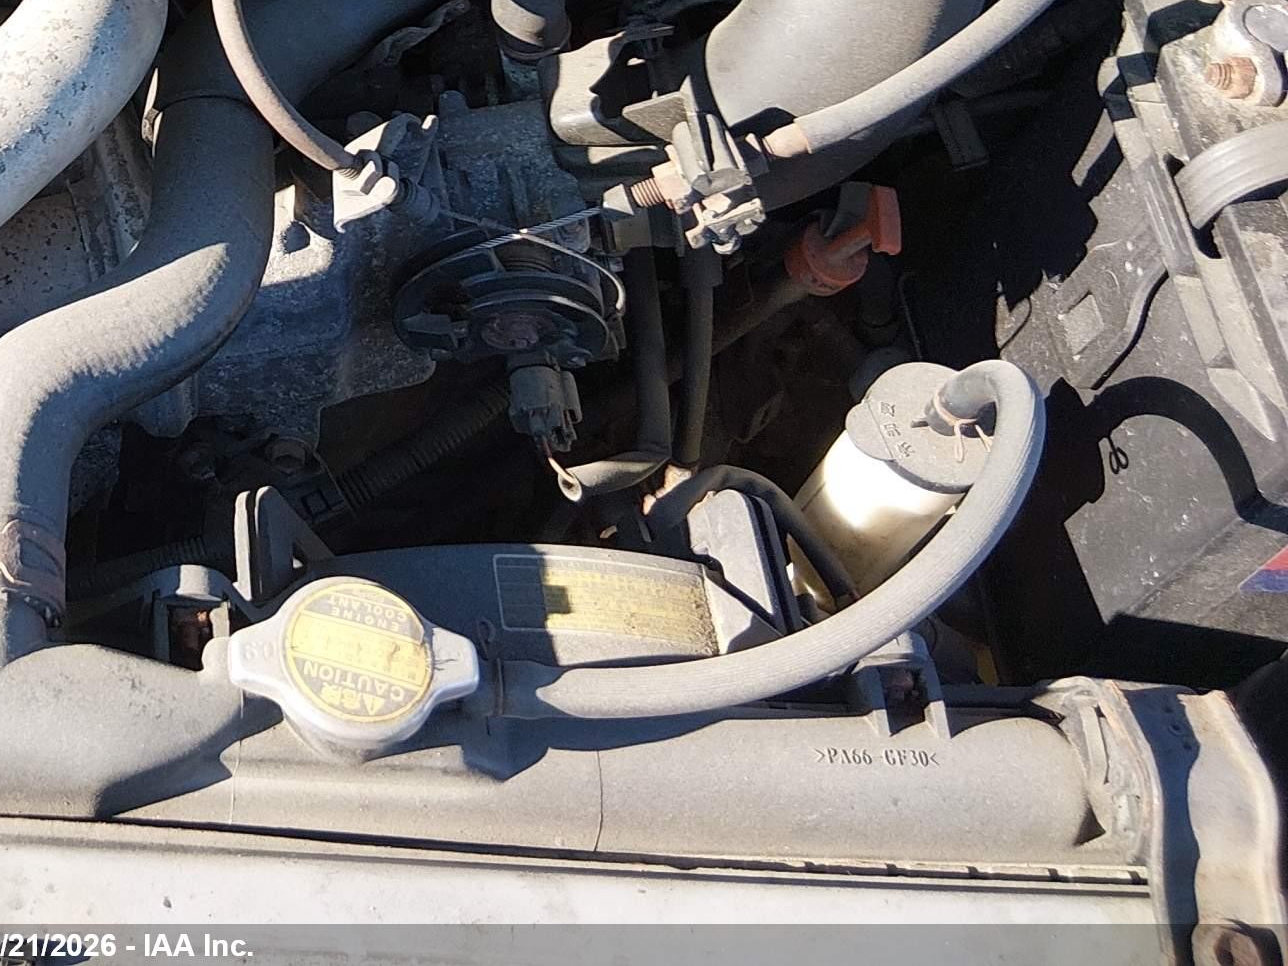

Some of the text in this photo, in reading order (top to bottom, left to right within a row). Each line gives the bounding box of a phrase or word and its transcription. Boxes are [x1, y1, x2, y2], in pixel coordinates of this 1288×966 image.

[327, 594, 407, 622] COOLANT
[329, 607, 400, 631] ENGINE
[303, 661, 405, 701] CAUTION
[320, 682, 361, 711] 危険
